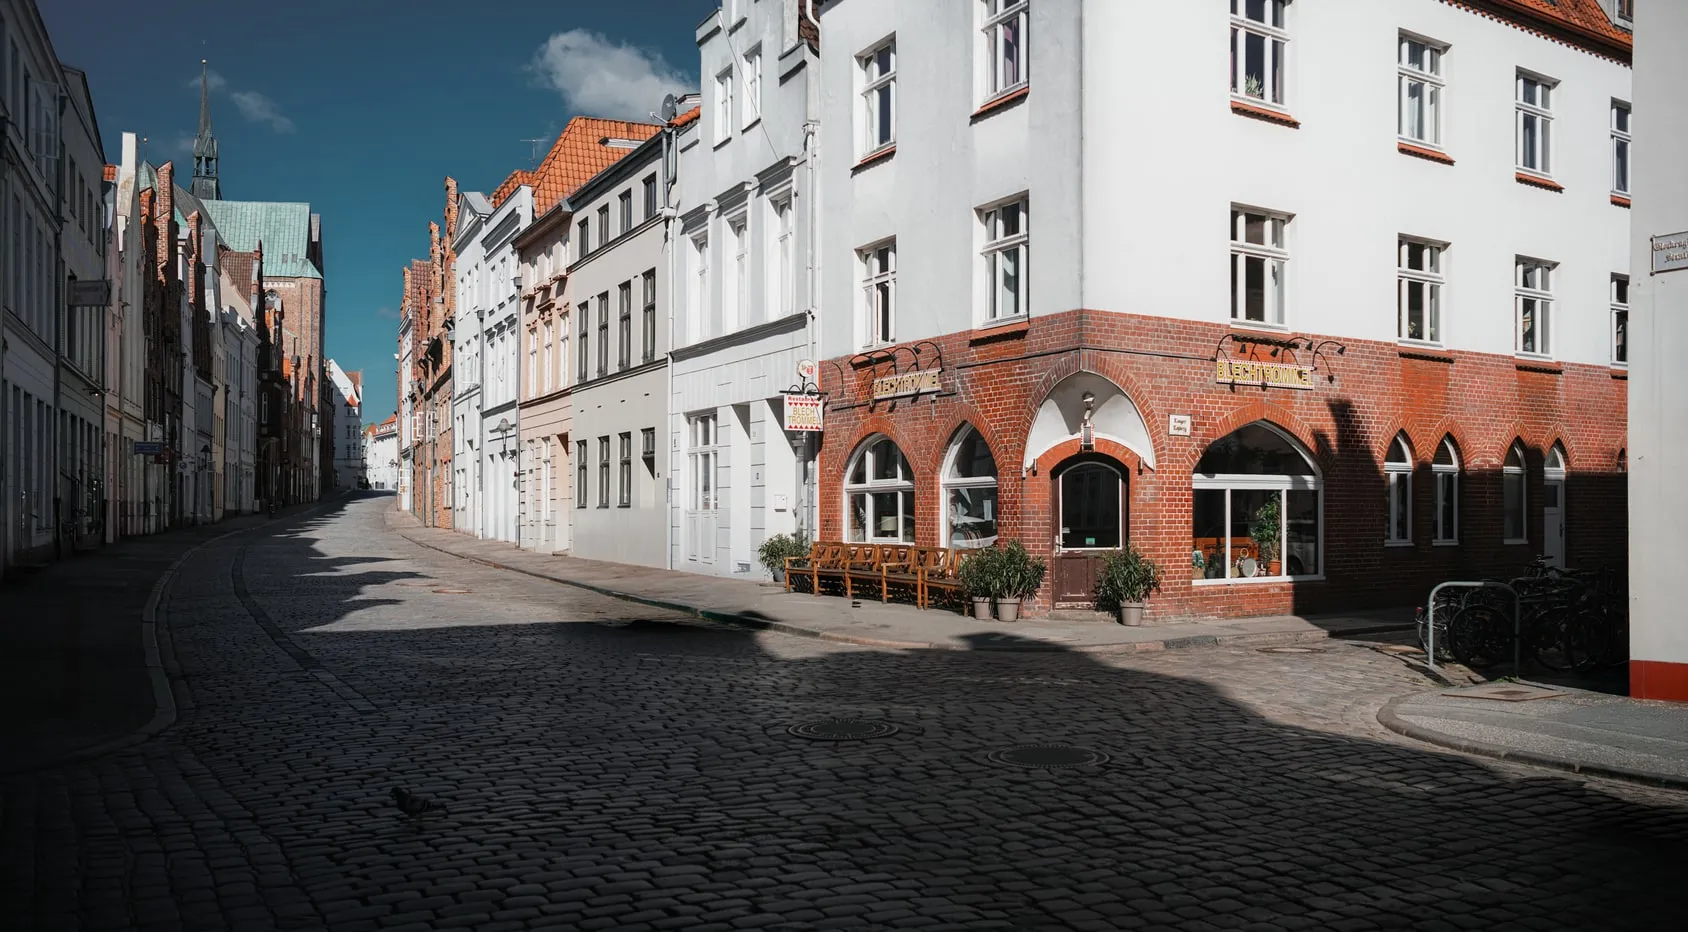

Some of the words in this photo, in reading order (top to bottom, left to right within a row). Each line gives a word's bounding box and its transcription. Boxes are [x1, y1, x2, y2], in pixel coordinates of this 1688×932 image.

[1217, 361, 1313, 385] BLECHTROMMEL
[793, 407, 815, 416] BLECH
[788, 416, 821, 425] TROMMEL
